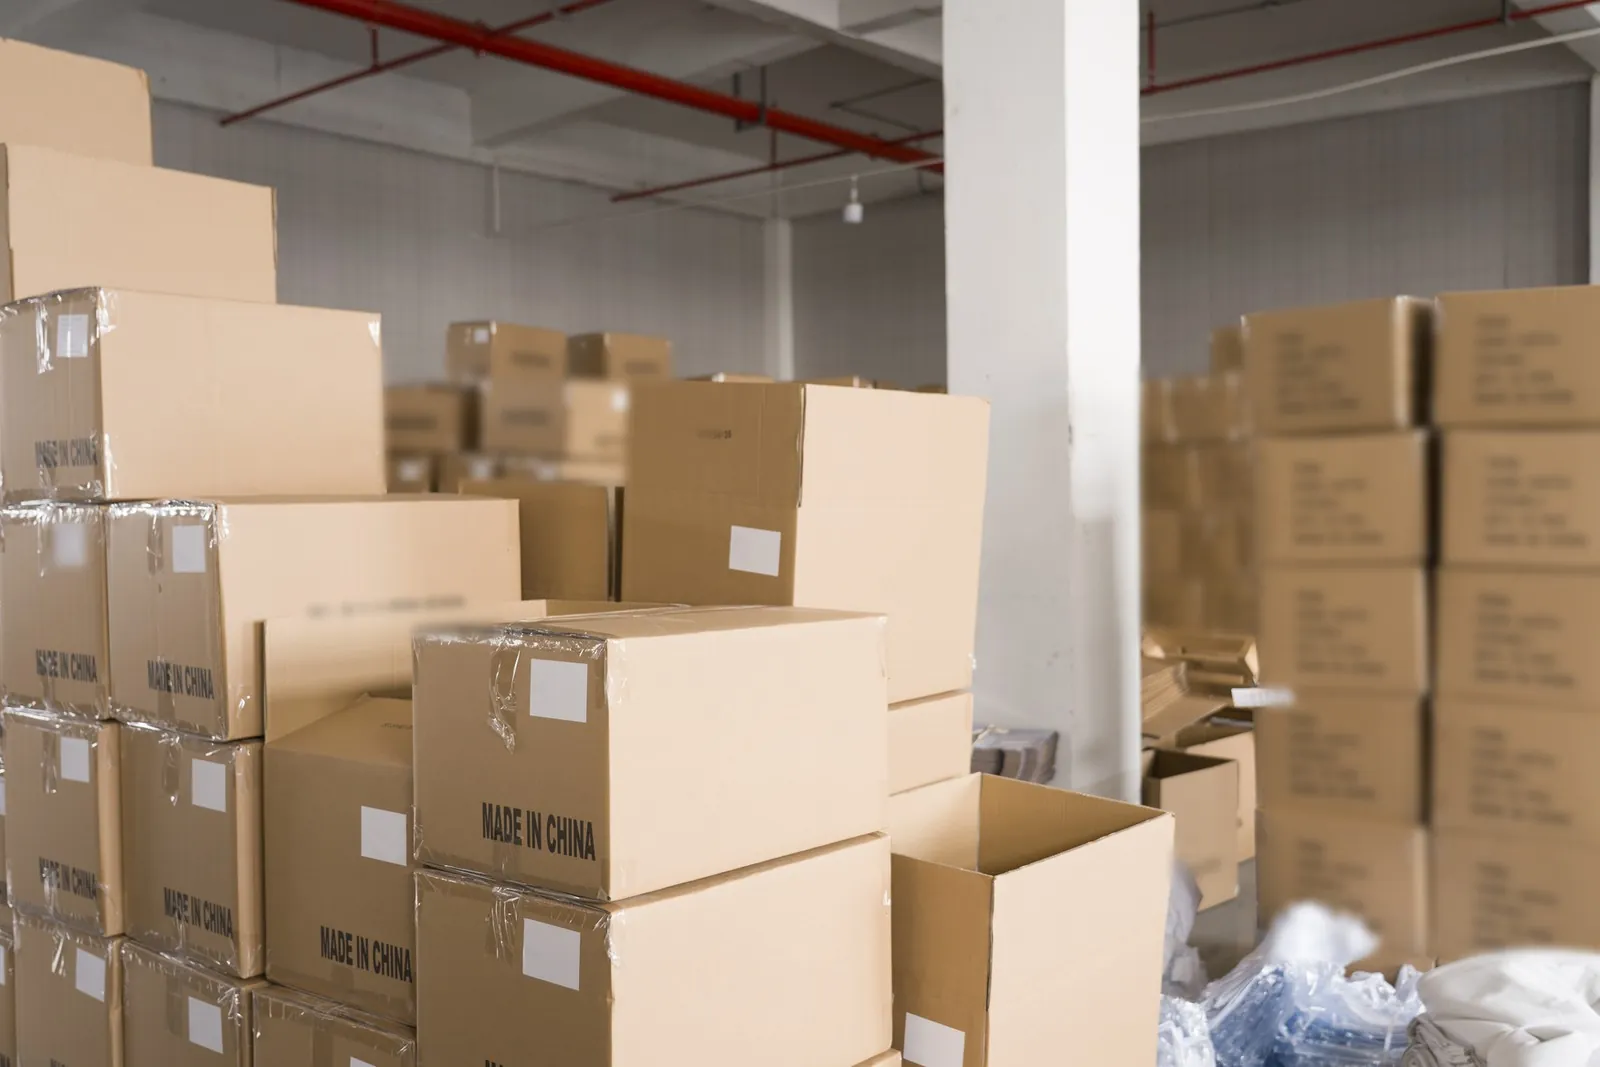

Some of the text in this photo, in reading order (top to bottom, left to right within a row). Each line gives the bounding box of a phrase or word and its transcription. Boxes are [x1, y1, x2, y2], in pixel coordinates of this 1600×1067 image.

[173, 663, 183, 695] IN
[185, 665, 215, 700] CHINA
[482, 802, 596, 861] MADE IN CHINA
[191, 895, 201, 929] IN
[203, 900, 233, 940] CHINA
[320, 925, 412, 983] MADE IN CHINA
